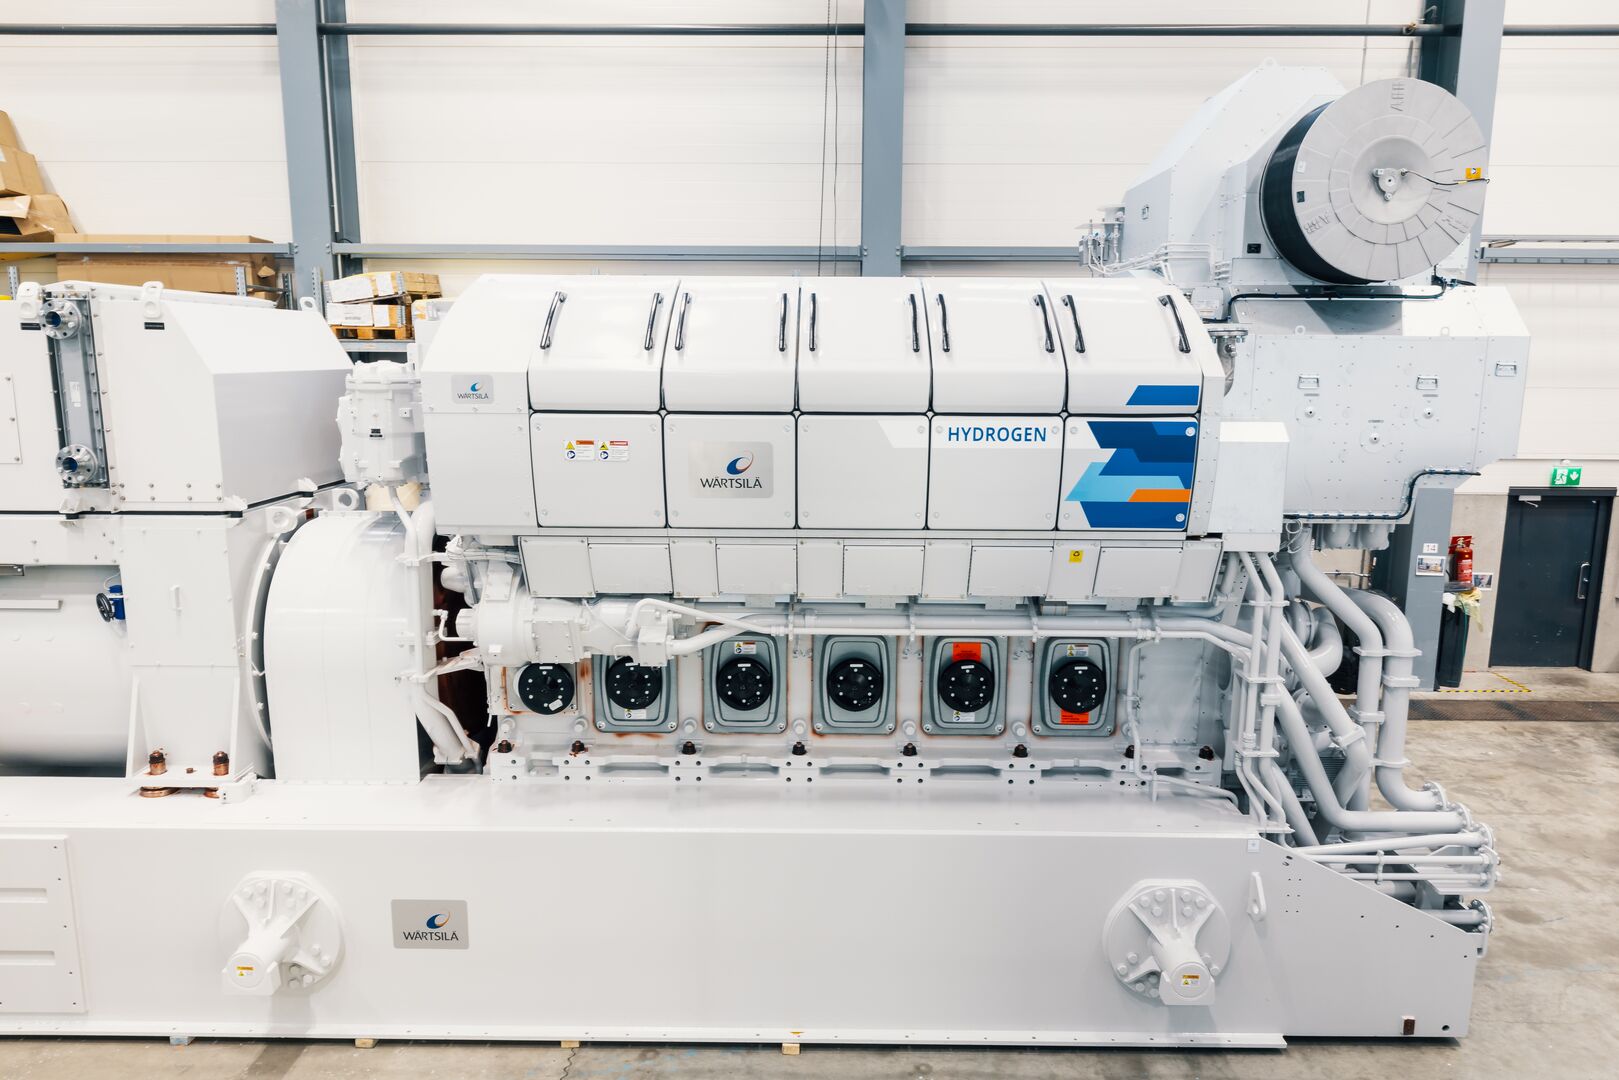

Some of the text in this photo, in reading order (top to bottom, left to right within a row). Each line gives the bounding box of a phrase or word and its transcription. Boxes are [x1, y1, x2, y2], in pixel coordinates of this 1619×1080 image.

[948, 426, 1047, 442] HYDROGEN
[699, 476, 763, 489] WÄRTSILÄ
[402, 929, 460, 941] WÄRTSILÄ
